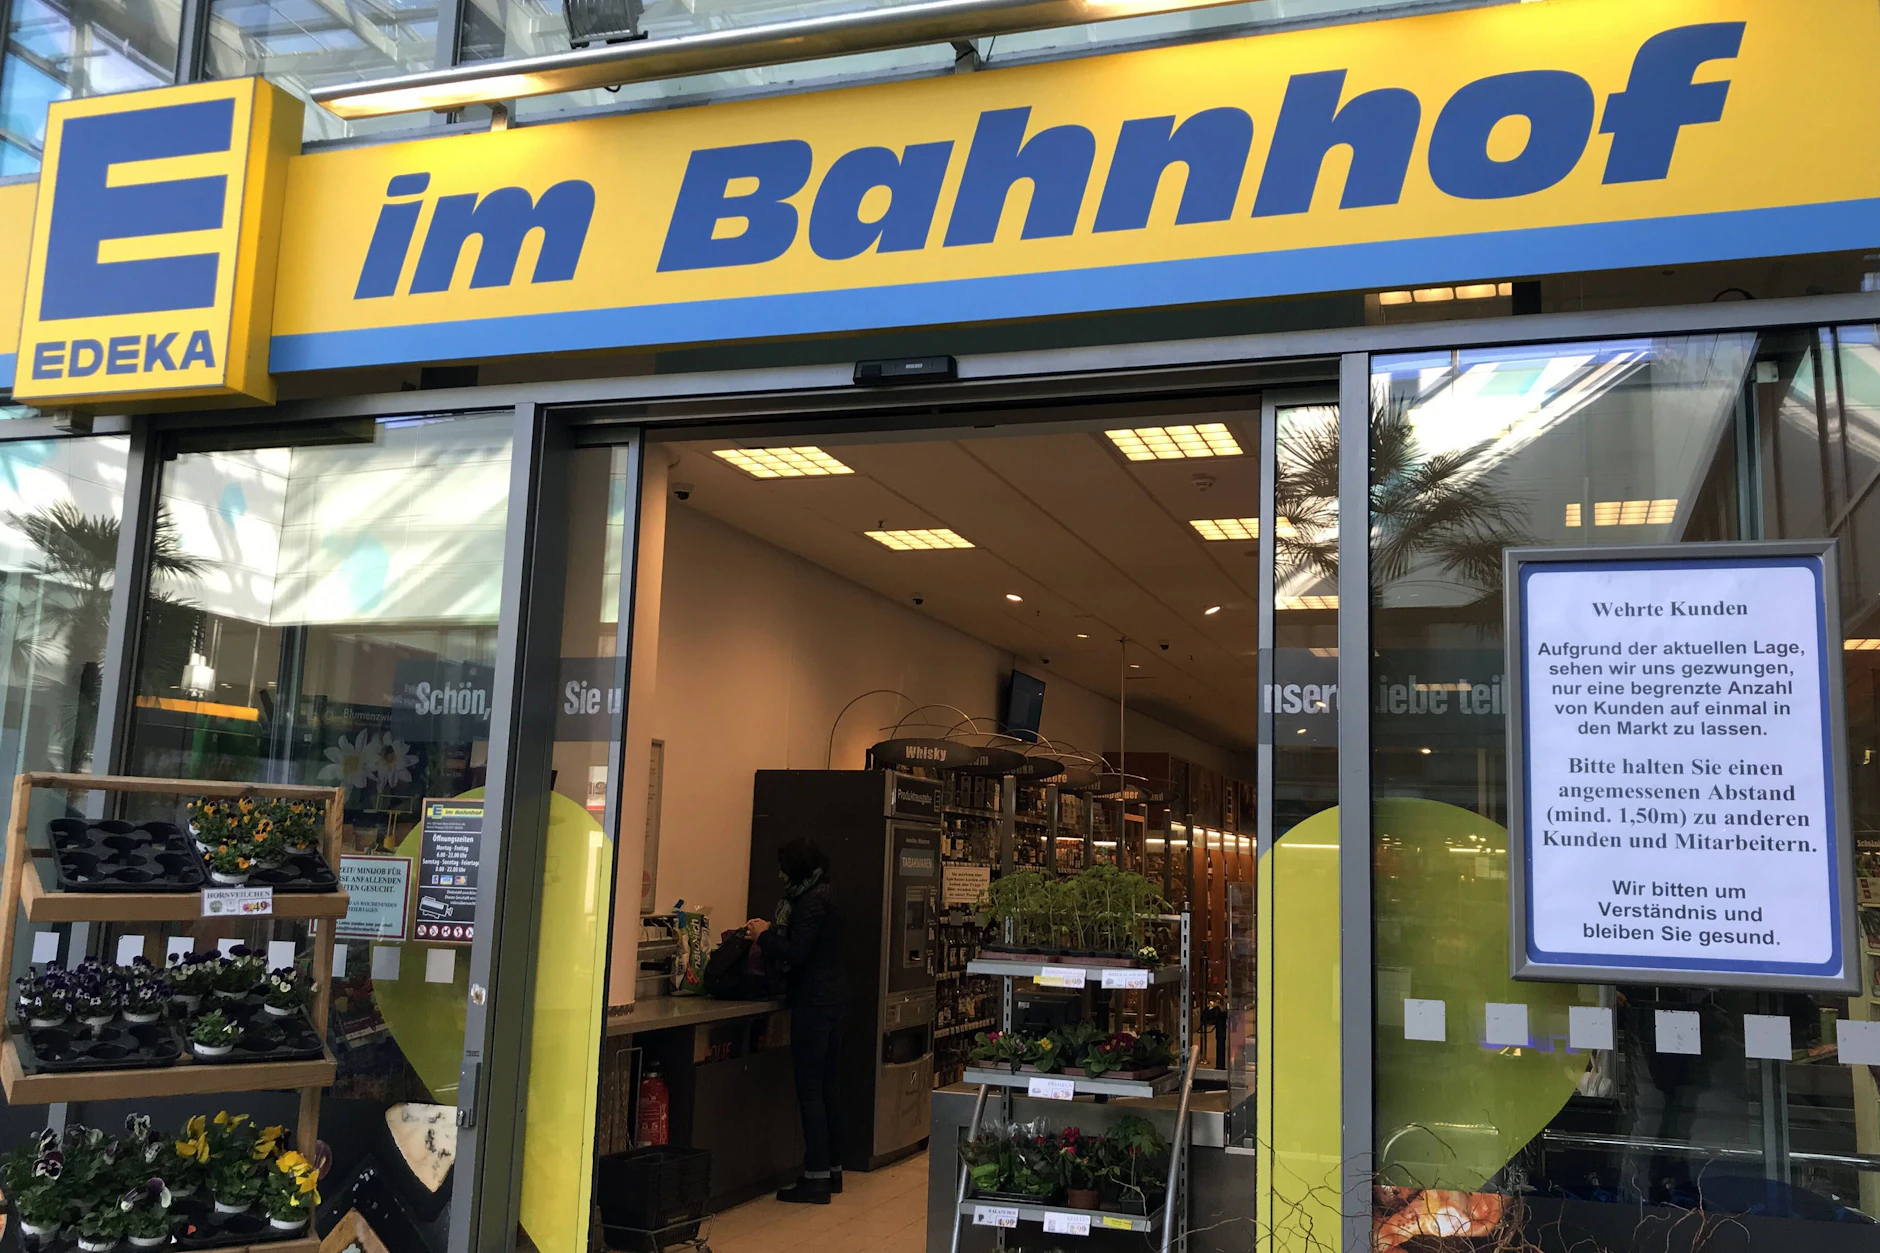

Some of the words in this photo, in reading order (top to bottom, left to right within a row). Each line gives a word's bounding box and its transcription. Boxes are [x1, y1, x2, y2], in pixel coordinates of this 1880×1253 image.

[353, 172, 596, 300] im
[655, 21, 1747, 274] Bahnhof
[39, 97, 236, 321] E
[31, 330, 216, 381] EDEKA
[1592, 602, 1663, 616] Wehrte
[1671, 600, 1747, 616] Kunden
[1538, 641, 1622, 659] Aufgrund
[1628, 641, 1658, 656] der
[1664, 640, 1747, 655] aktuellen
[1754, 640, 1805, 658] Lage,
[1550, 662, 1603, 675] sehen
[1609, 661, 1637, 675] wir
[1643, 664, 1676, 675] uns
[1681, 662, 1794, 679] gezwungen,
[1553, 683, 1582, 694] nur
[1588, 681, 1625, 695] eine
[1631, 681, 1722, 699] begrenzte
[1728, 680, 1793, 695] Anzahl
[415, 681, 490, 720] Schön,
[564, 680, 601, 715] Sie
[1555, 703, 1588, 715] von
[1595, 700, 1664, 715] Kunden
[1671, 700, 1700, 716] auf
[1705, 700, 1767, 716] einmal
[1774, 700, 1791, 716] in
[1578, 720, 1611, 735] den
[1618, 720, 1669, 736] Markt
[1674, 723, 1695, 736] zu
[1702, 721, 1768, 736] lassen.
[905, 745, 947, 762] Whisky
[1569, 757, 1616, 774] Bitte
[1623, 758, 1685, 775] halten
[1692, 758, 1722, 776] Sie
[1729, 759, 1783, 776] einen
[1559, 785, 1701, 803] angemessenen
[1708, 784, 1796, 802] Abstand
[1547, 806, 1612, 826] (mind.
[1621, 807, 1687, 828] 1,50m)
[1694, 812, 1717, 825] zu
[1725, 809, 1810, 827] anderen
[432, 834, 474, 844] Öffnungszeiten
[1543, 830, 1622, 848] Kunden
[1630, 832, 1668, 849] und
[1676, 833, 1817, 853] Mitarbeitern.
[352, 876, 402, 884] ANFALLENDEN
[357, 867, 386, 875] MINIJOB
[388, 867, 402, 876] FÜR
[207, 891, 270, 899] HORNVEILCHEN
[360, 885, 396, 894] GESUCHT.
[1612, 879, 1646, 896] Wir
[1653, 881, 1708, 898] bitten
[1716, 885, 1746, 899] um
[1597, 901, 1718, 921] Verständnis
[1725, 906, 1763, 923] und
[1584, 922, 1654, 941] bleiben
[1662, 925, 1692, 942] Sie
[1699, 928, 1781, 947] gesund.
